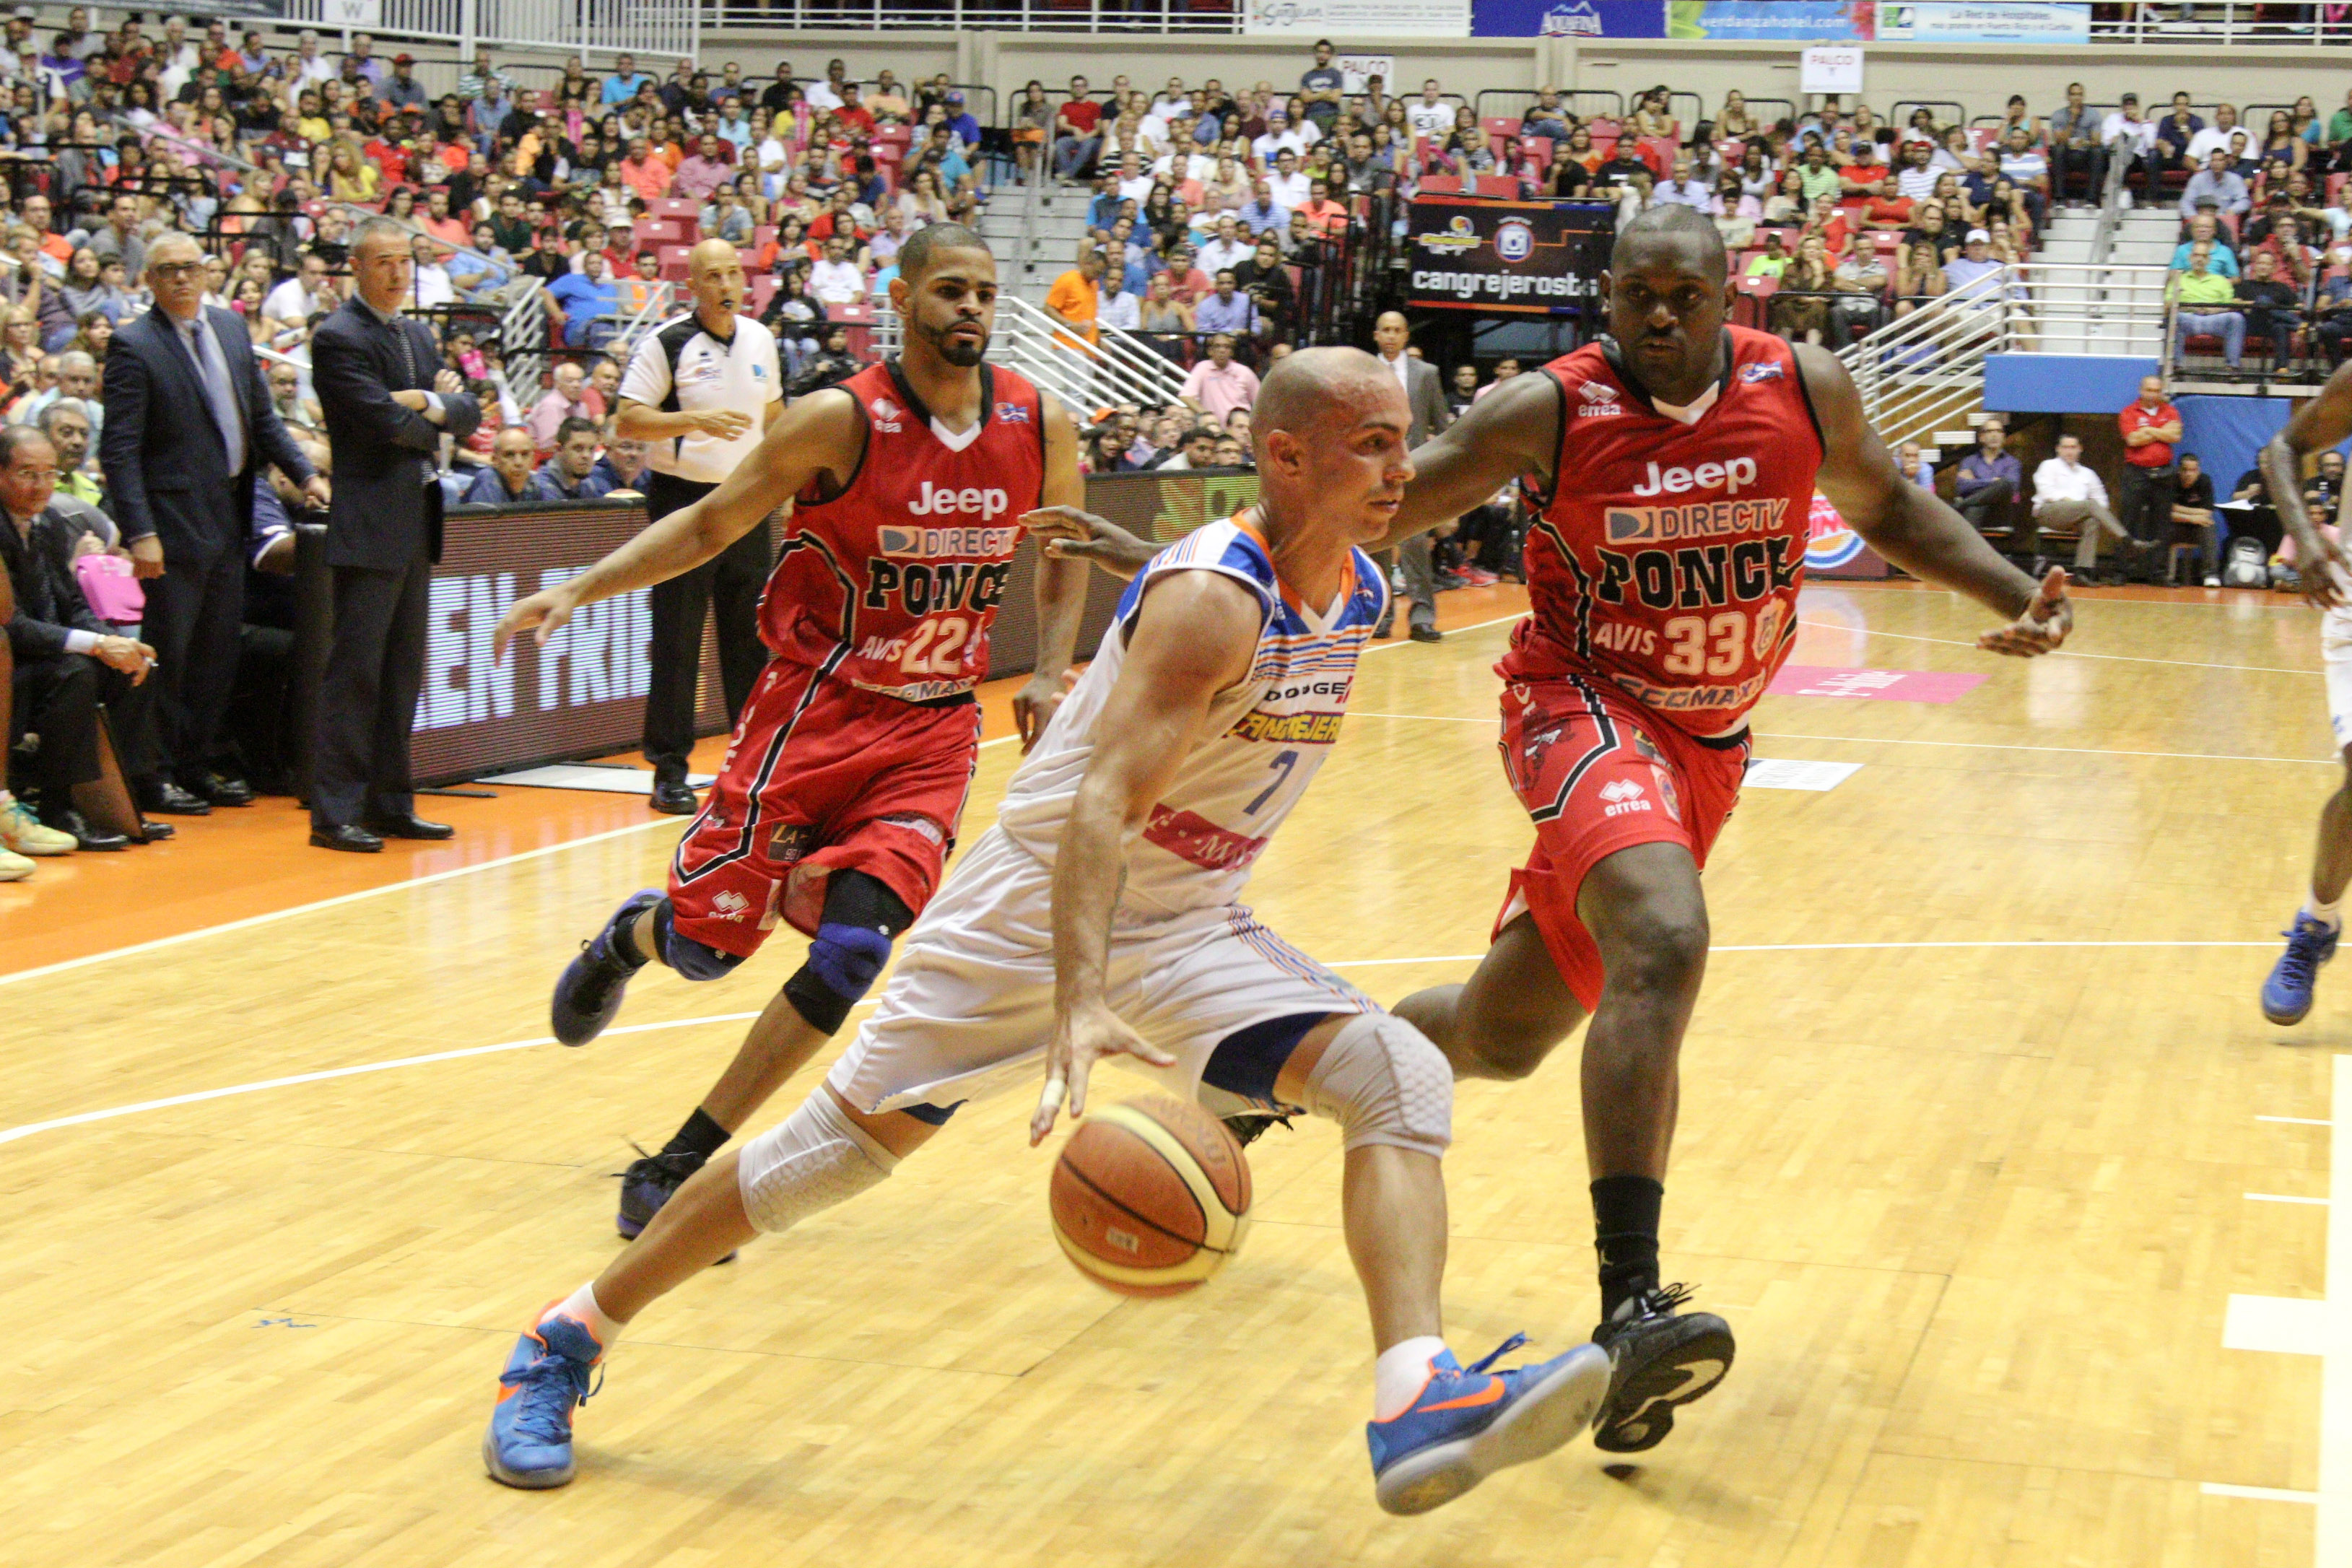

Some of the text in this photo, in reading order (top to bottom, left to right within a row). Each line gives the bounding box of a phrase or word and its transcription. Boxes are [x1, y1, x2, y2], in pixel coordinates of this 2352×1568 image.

[1578, 402, 1621, 417] errea
[1633, 456, 1756, 497] Jeep
[907, 481, 1009, 521] Jeep
[1661, 500, 1786, 537] DIRECTV
[925, 528, 1014, 556] DIRECT
[1595, 536, 1793, 611] PONCE
[900, 617, 970, 675] 22
[1594, 622, 1658, 655] AVIS
[1663, 611, 1748, 676] 33
[1242, 749, 1299, 816] 7
[1604, 798, 1652, 818] errea
